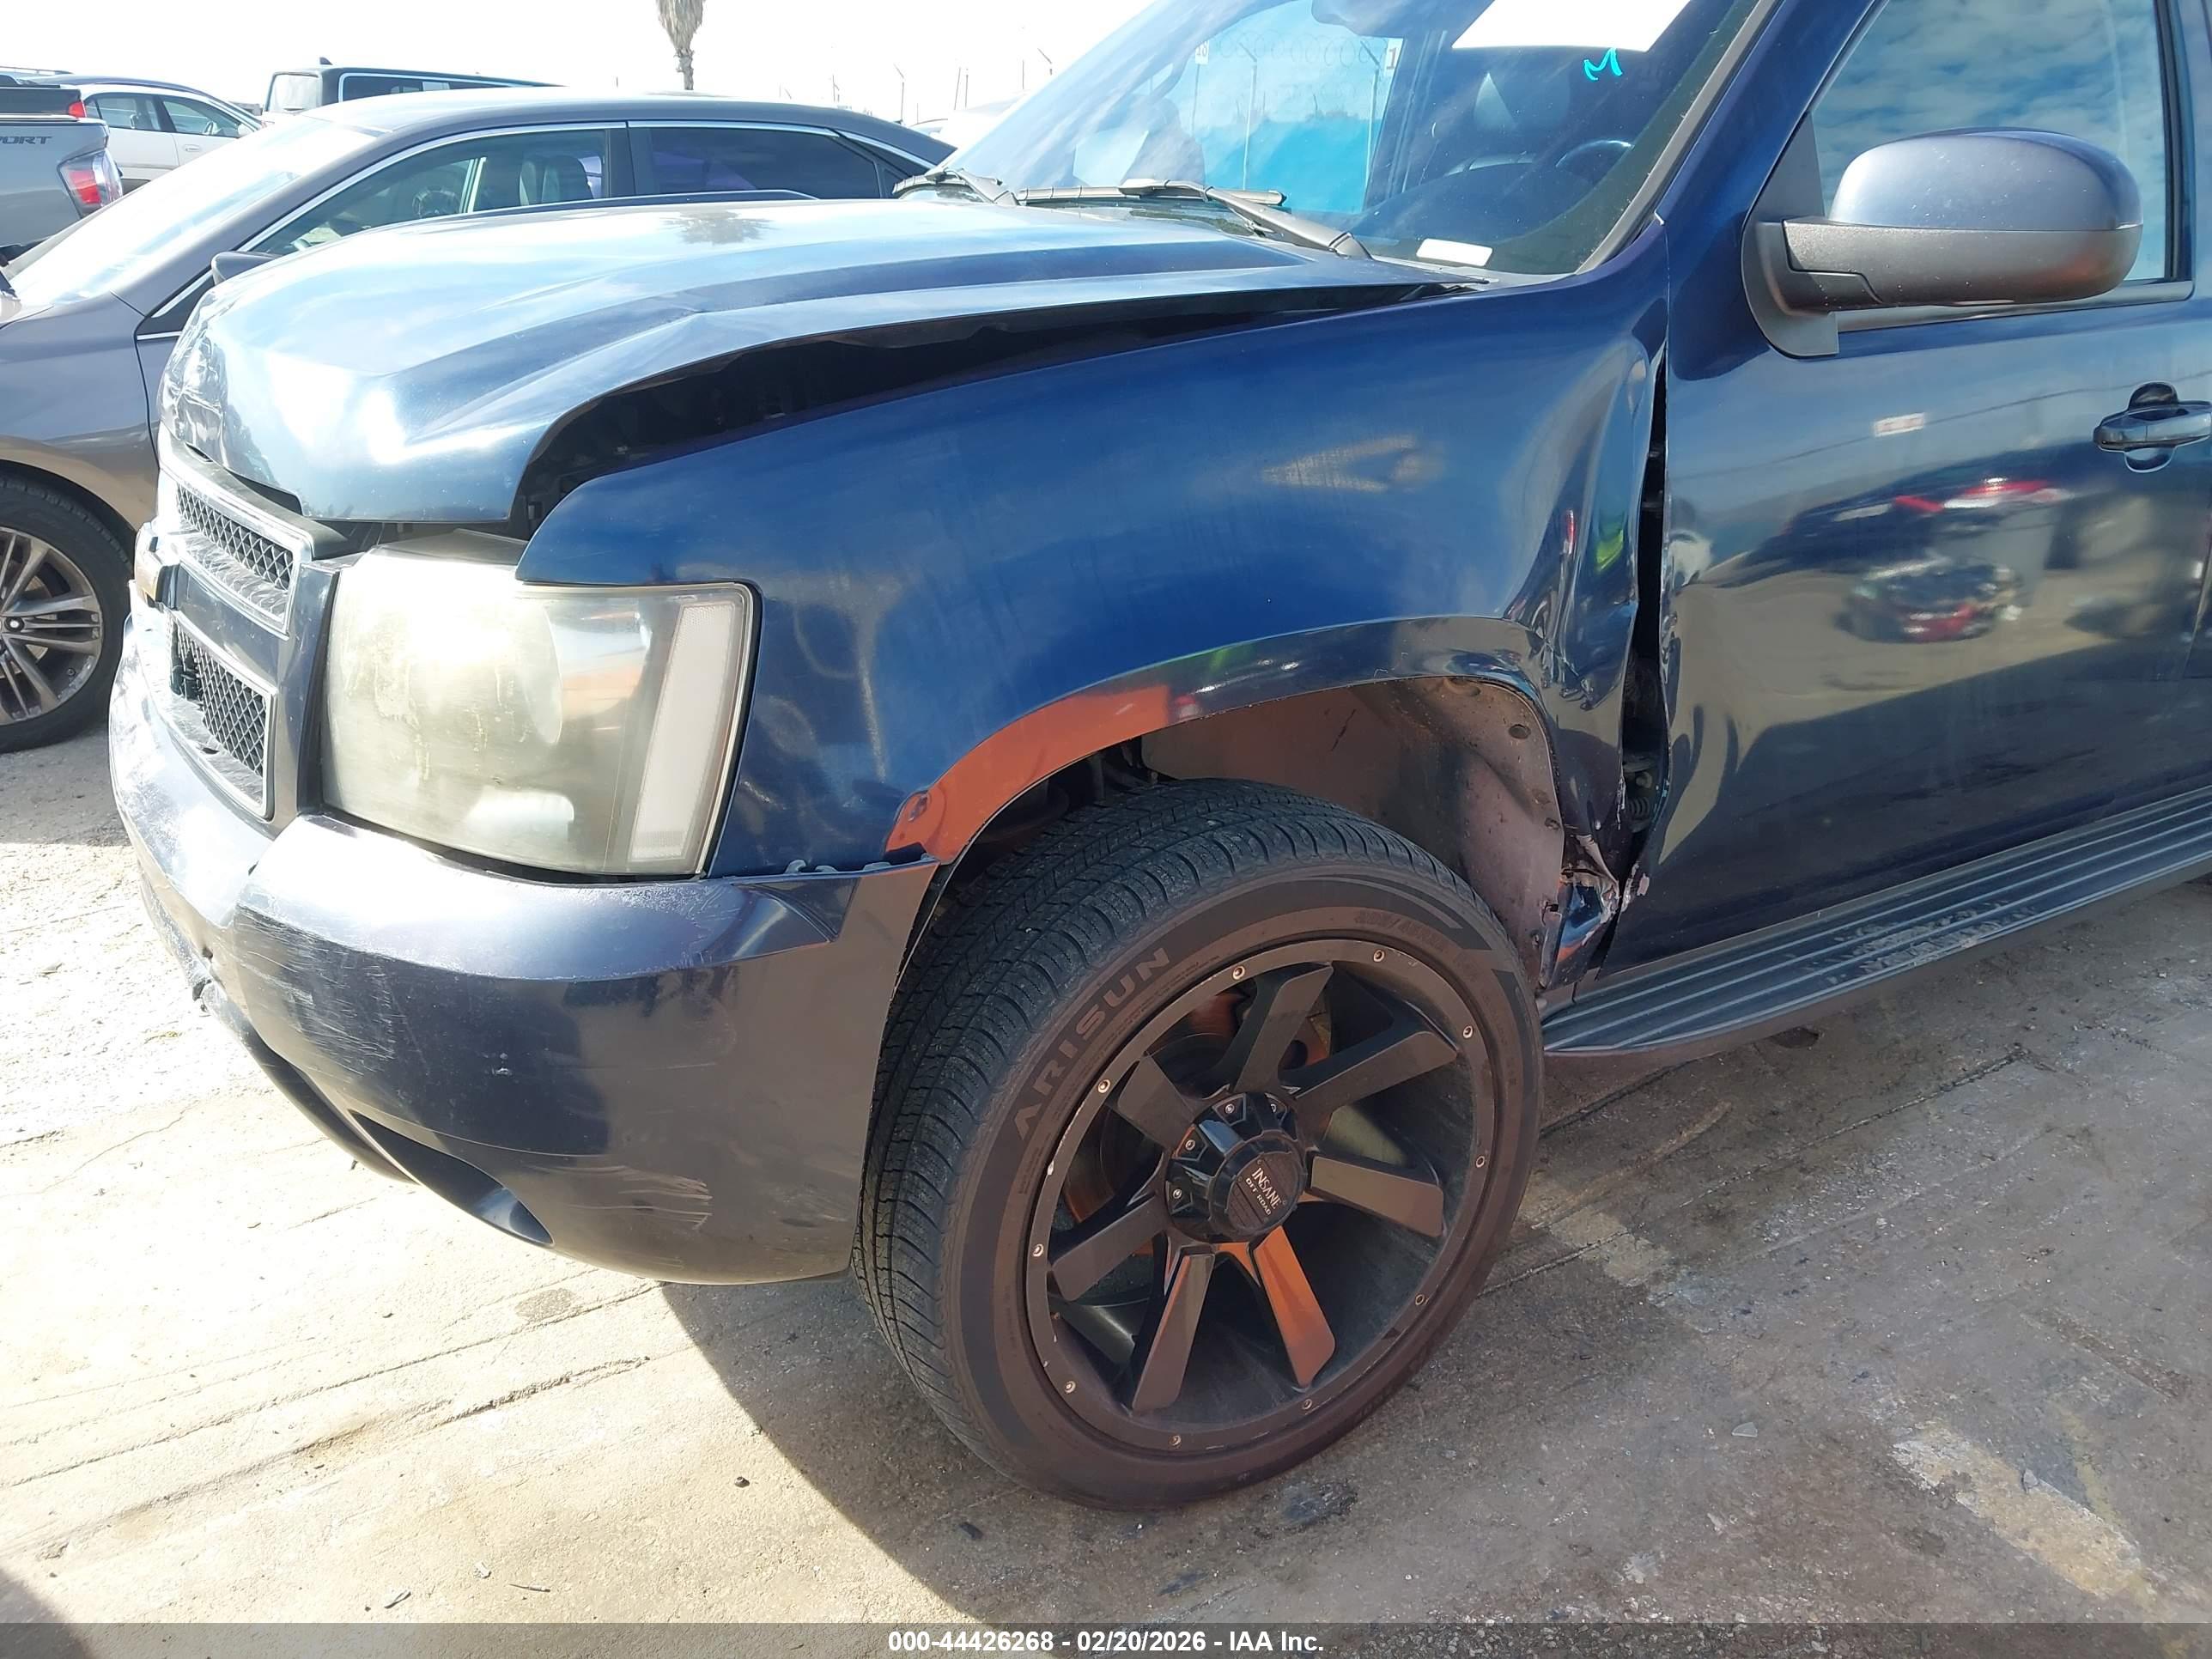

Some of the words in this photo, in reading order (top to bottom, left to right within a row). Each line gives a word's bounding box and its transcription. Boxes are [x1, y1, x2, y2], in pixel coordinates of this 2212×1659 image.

[1014, 947, 1170, 1140] ARISUN
[1252, 1167, 1282, 1210] INSANE
[1256, 1194, 1272, 1215] ROAD
